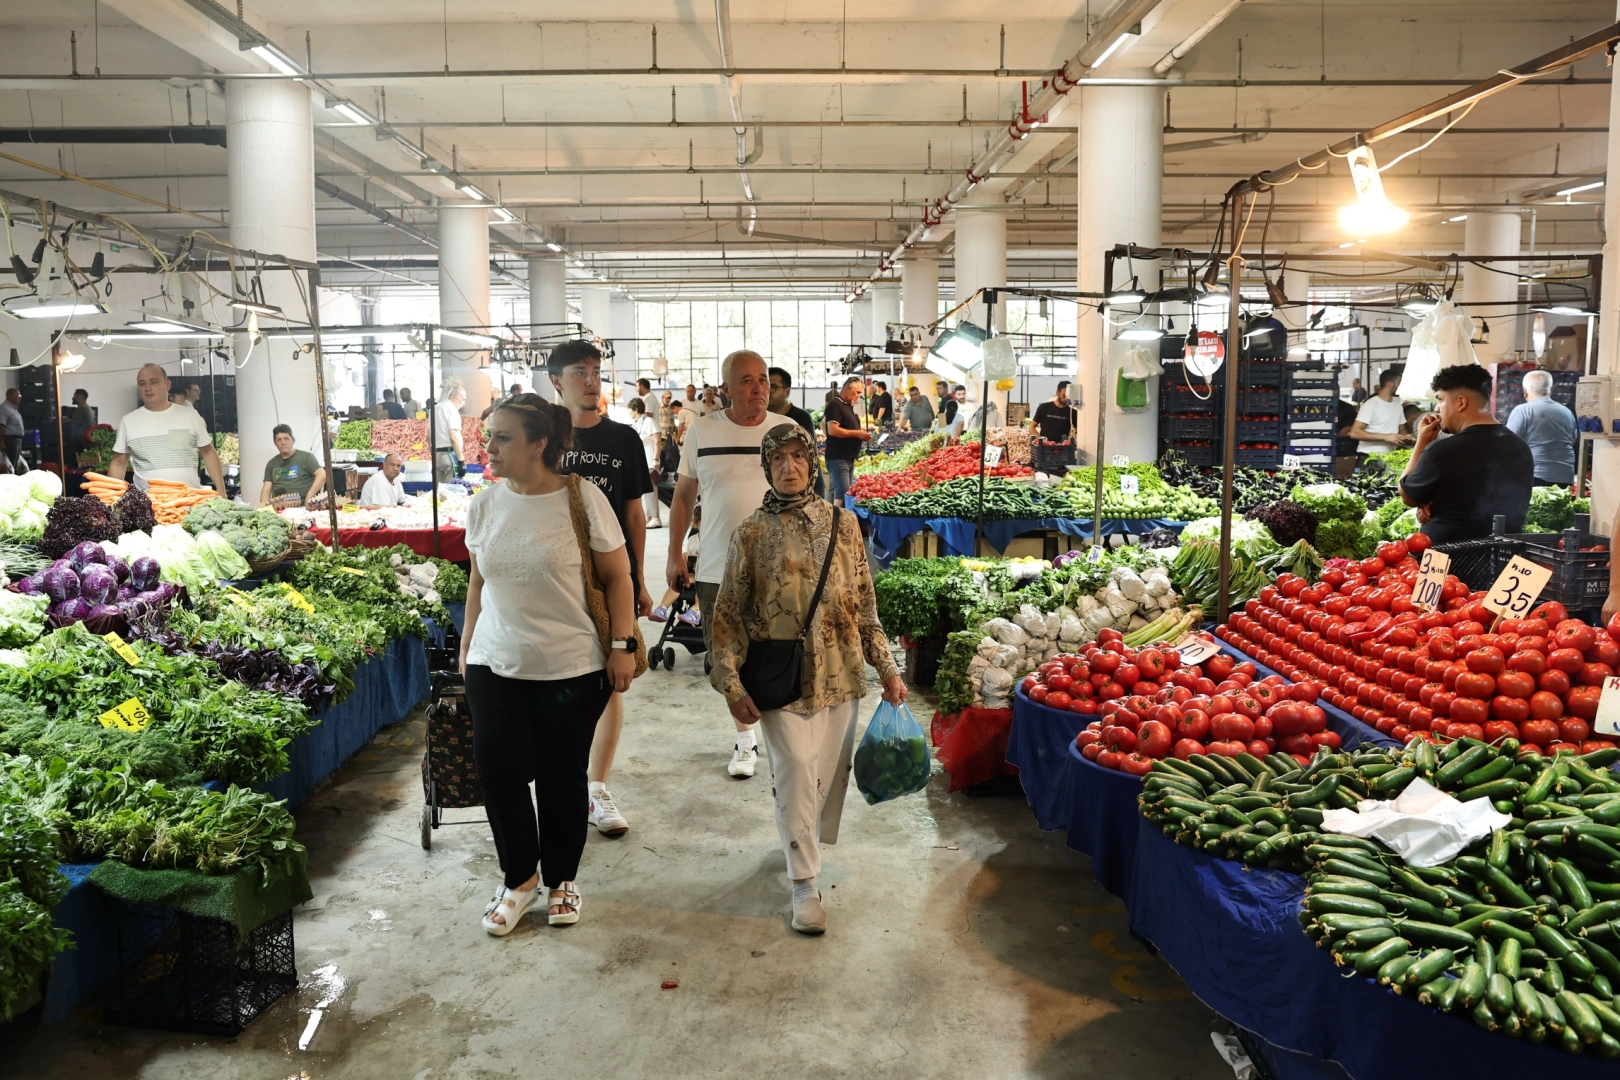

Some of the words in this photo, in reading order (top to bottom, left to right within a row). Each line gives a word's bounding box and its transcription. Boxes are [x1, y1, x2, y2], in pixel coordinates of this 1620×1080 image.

[612, 459, 622, 469] OF
[1420, 553, 1432, 575] 3
[1413, 578, 1442, 606] 100
[1493, 576, 1532, 612] 35
[1609, 678, 1620, 690] K
